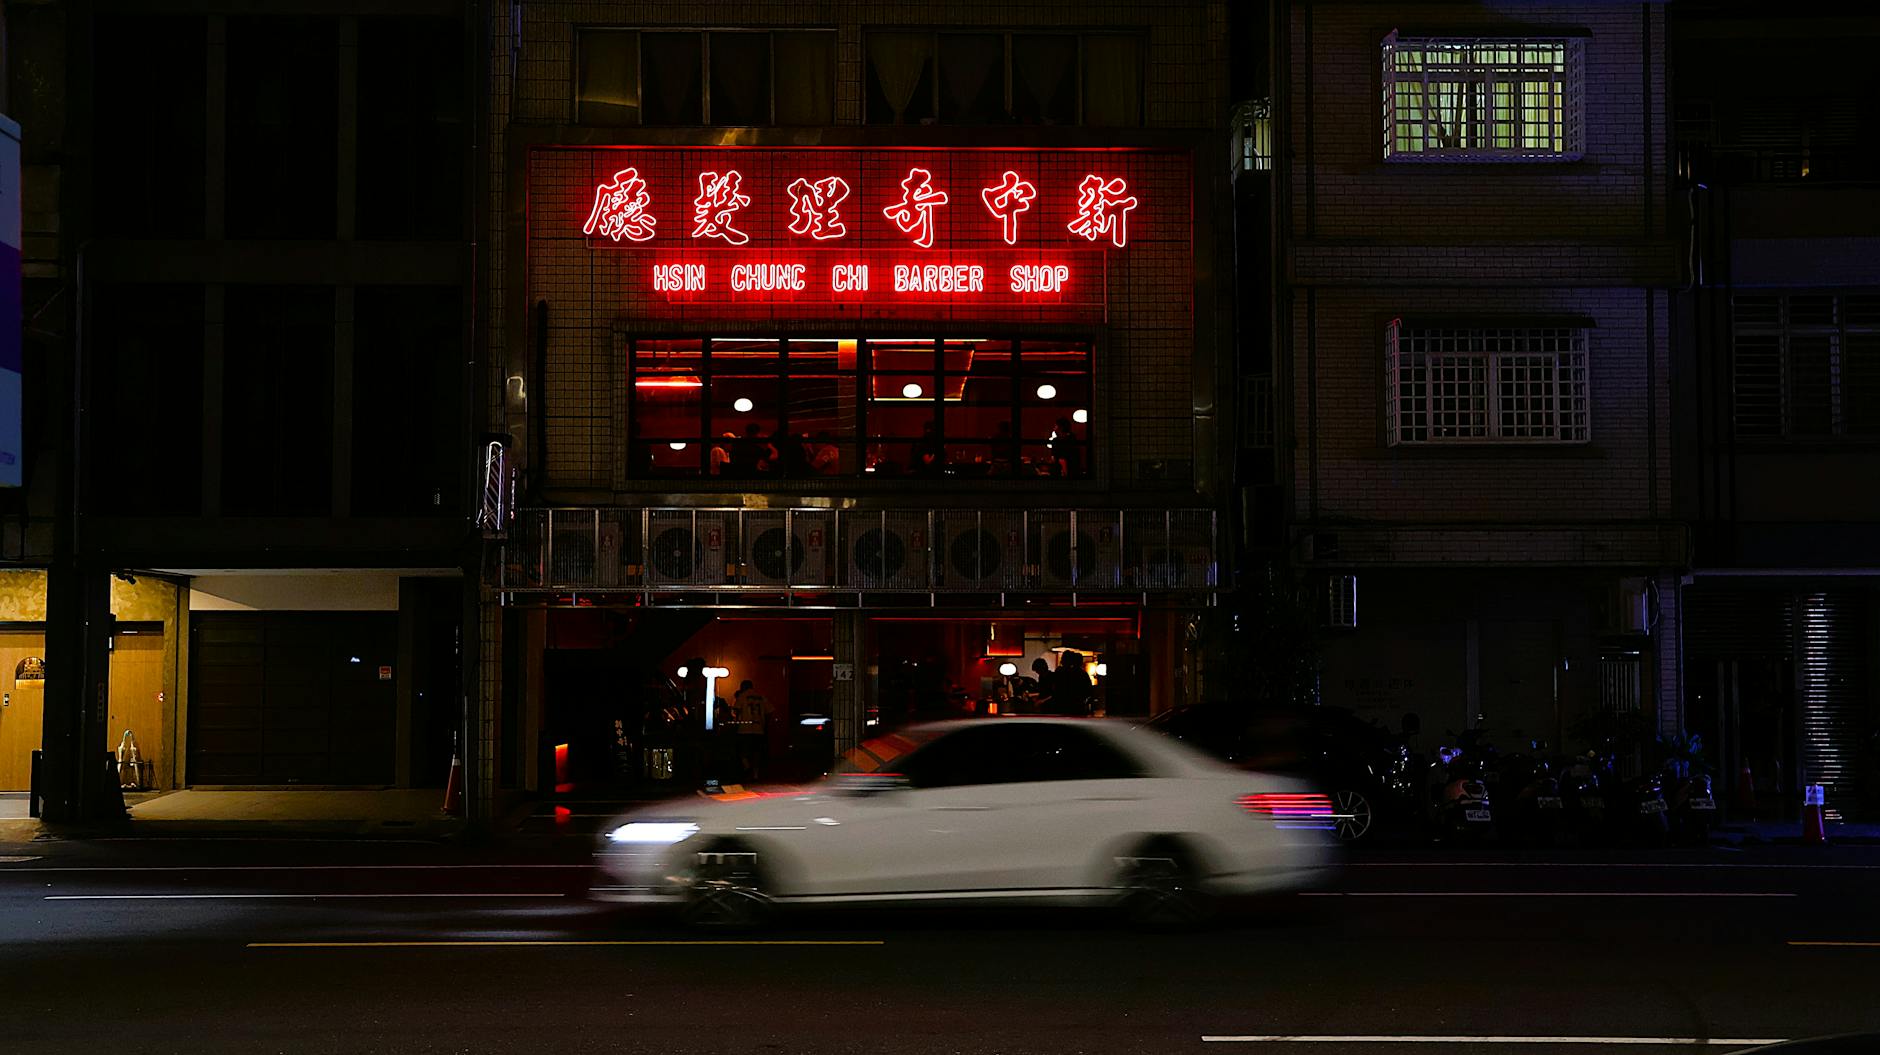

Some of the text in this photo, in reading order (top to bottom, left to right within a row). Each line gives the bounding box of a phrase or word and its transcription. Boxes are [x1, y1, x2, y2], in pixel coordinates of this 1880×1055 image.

[653, 264, 705, 291] HSIN
[832, 264, 868, 292] CHI
[893, 264, 984, 292] BARBER
[1009, 264, 1069, 292] SHOP
